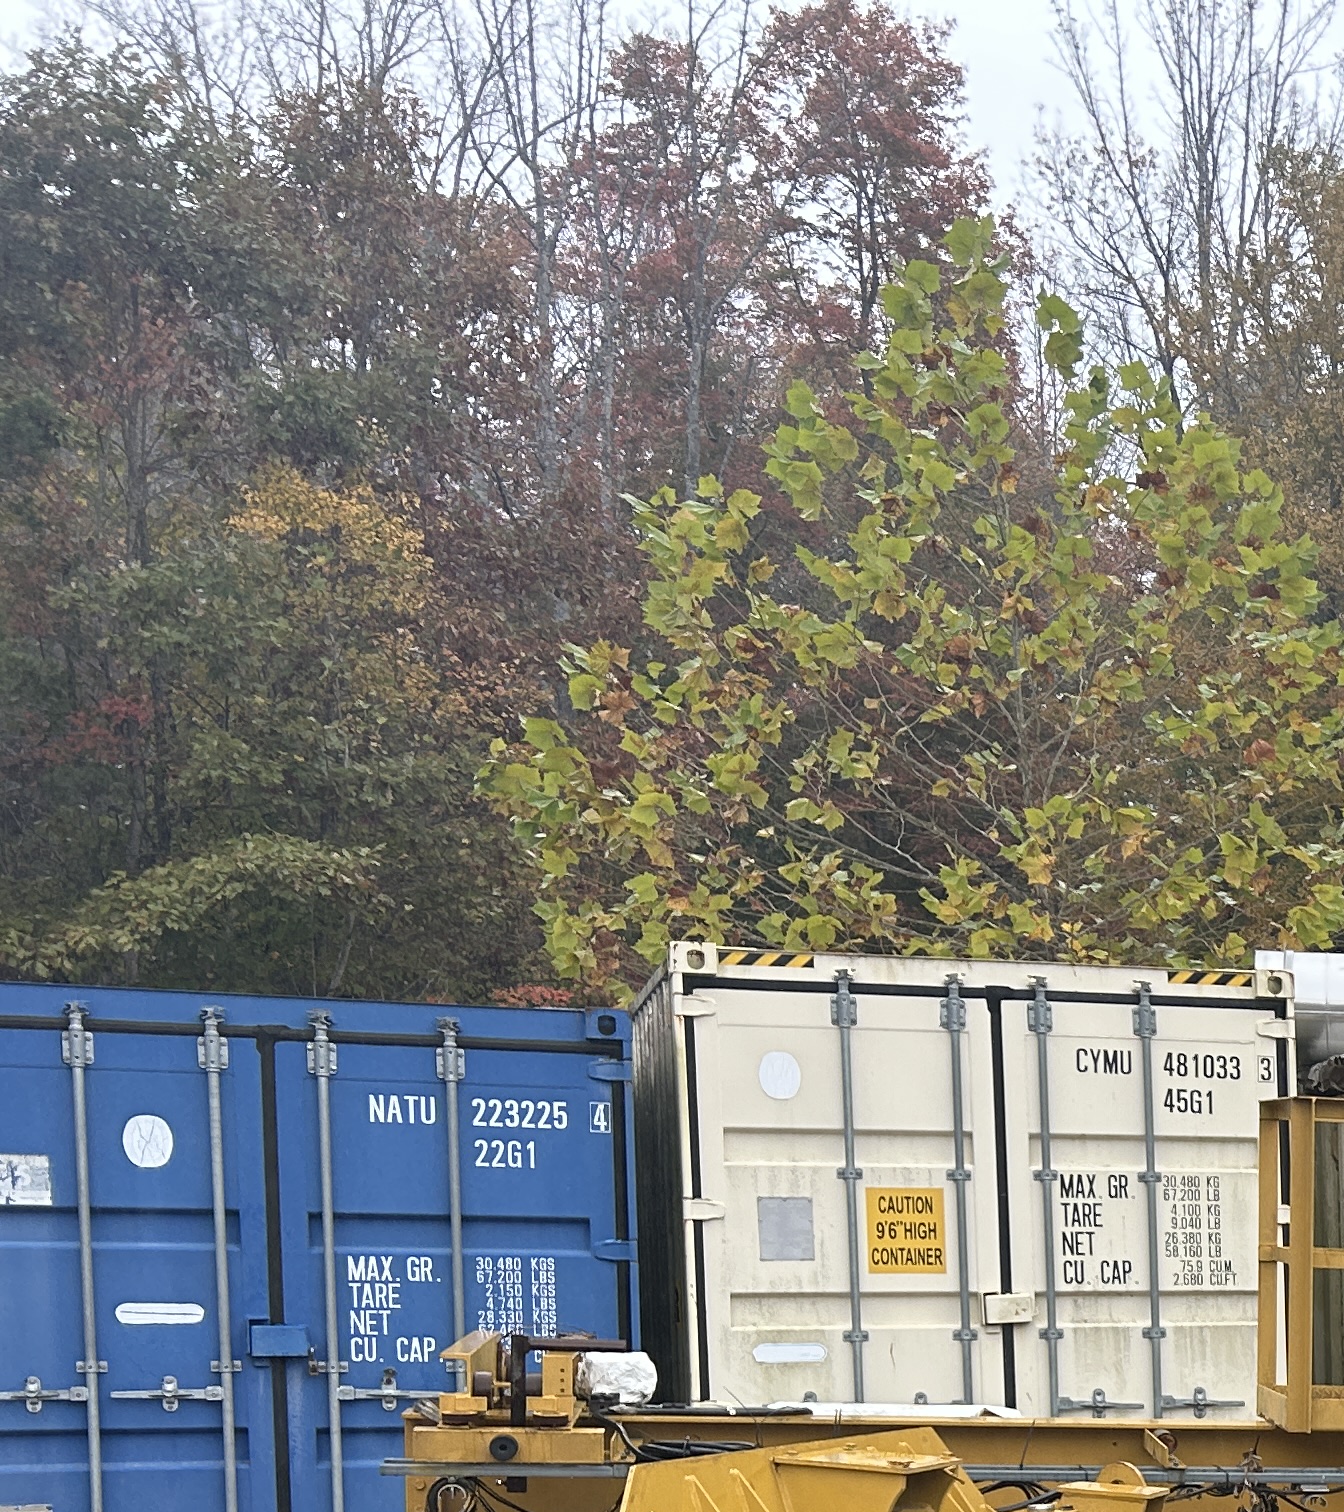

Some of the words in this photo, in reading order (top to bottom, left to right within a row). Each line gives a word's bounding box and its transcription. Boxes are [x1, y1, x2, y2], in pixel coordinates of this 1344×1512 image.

[1075, 1048, 1133, 1075] CYMU
[1163, 1052, 1241, 1080] 481033
[1259, 1056, 1273, 1082] 3
[1163, 1087, 1214, 1115] 45G1
[368, 1093, 437, 1125] NATU
[471, 1097, 569, 1130] 223225
[592, 1103, 609, 1133] 4
[474, 1138, 537, 1170] 22G1
[1059, 1173, 1104, 1200] MAX.
[1107, 1173, 1136, 1200] GR.
[1206, 1175, 1220, 1189] KG
[877, 1195, 934, 1215] CAUTION
[1206, 1188, 1221, 1202] LB
[1060, 1202, 1104, 1228] TARE
[1207, 1203, 1221, 1218] KG
[1207, 1216, 1221, 1230] LB
[1061, 1230, 1096, 1257] NET
[1207, 1231, 1222, 1245] KG
[871, 1246, 944, 1267] CONTAINER
[1208, 1244, 1222, 1258] LB
[347, 1255, 401, 1282] MAX.
[406, 1255, 442, 1283] GR.
[530, 1256, 555, 1271] KGS
[1100, 1259, 1140, 1286] CAP.
[531, 1270, 556, 1285] LBS
[348, 1282, 402, 1309] TARE
[531, 1283, 556, 1298] KGS
[532, 1297, 557, 1311] LBS
[349, 1309, 392, 1336] NET
[532, 1310, 557, 1325] KGS
[350, 1336, 384, 1363] CU.
[396, 1336, 444, 1364] CAP.
